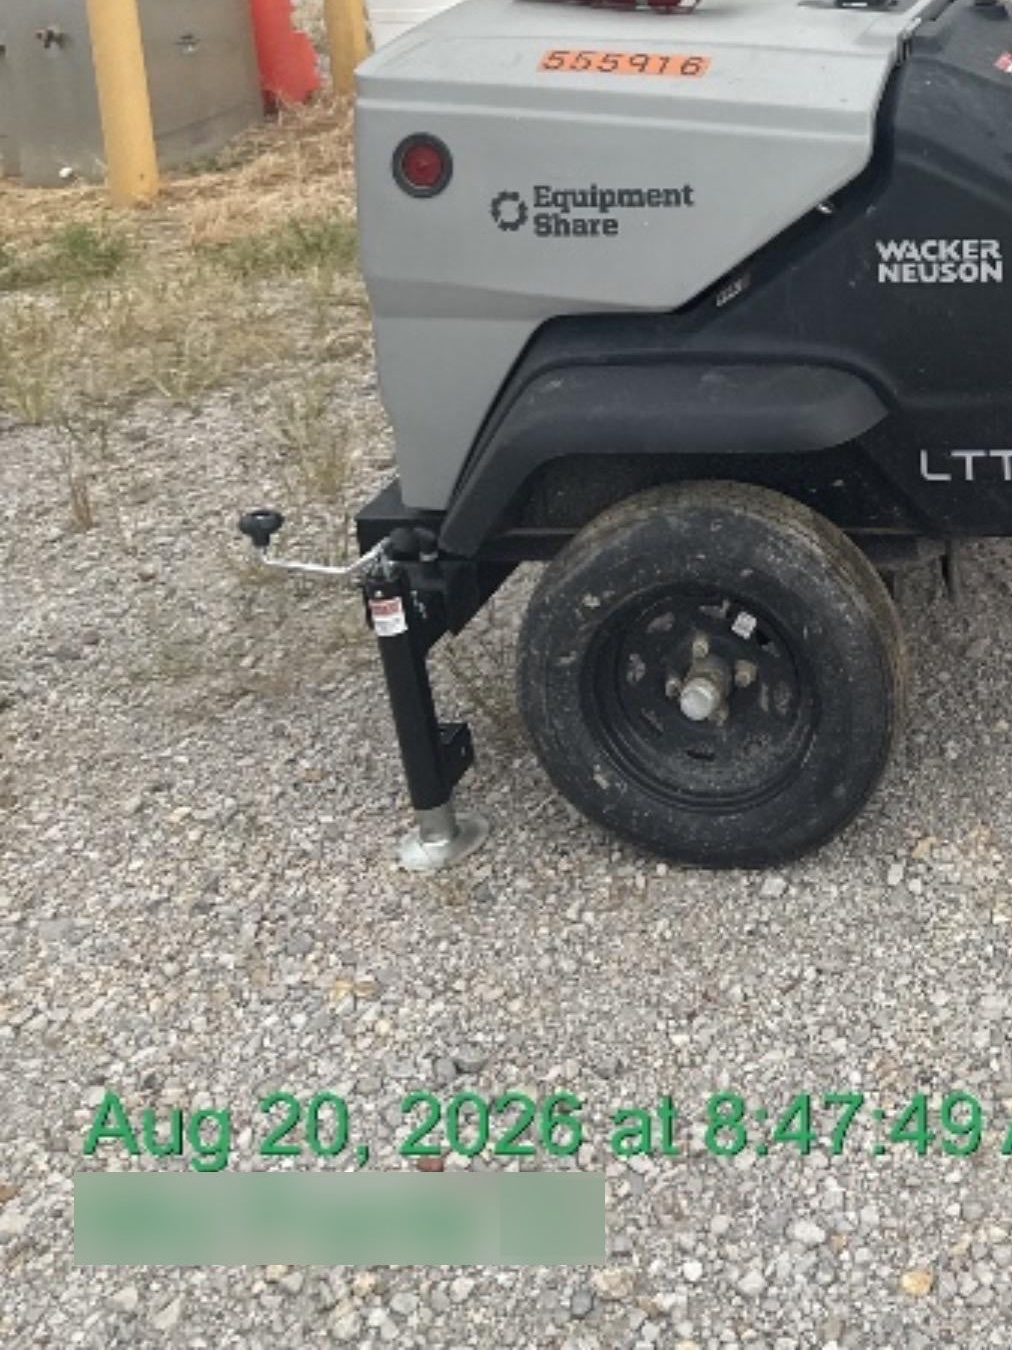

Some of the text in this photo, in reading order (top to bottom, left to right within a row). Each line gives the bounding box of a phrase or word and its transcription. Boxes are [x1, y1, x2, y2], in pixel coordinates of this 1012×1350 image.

[542, 50, 705, 76] 555916
[533, 184, 694, 213] Equipment
[533, 213, 618, 237] Share
[875, 239, 1002, 261] WACKER
[878, 260, 1003, 283] NEUSON
